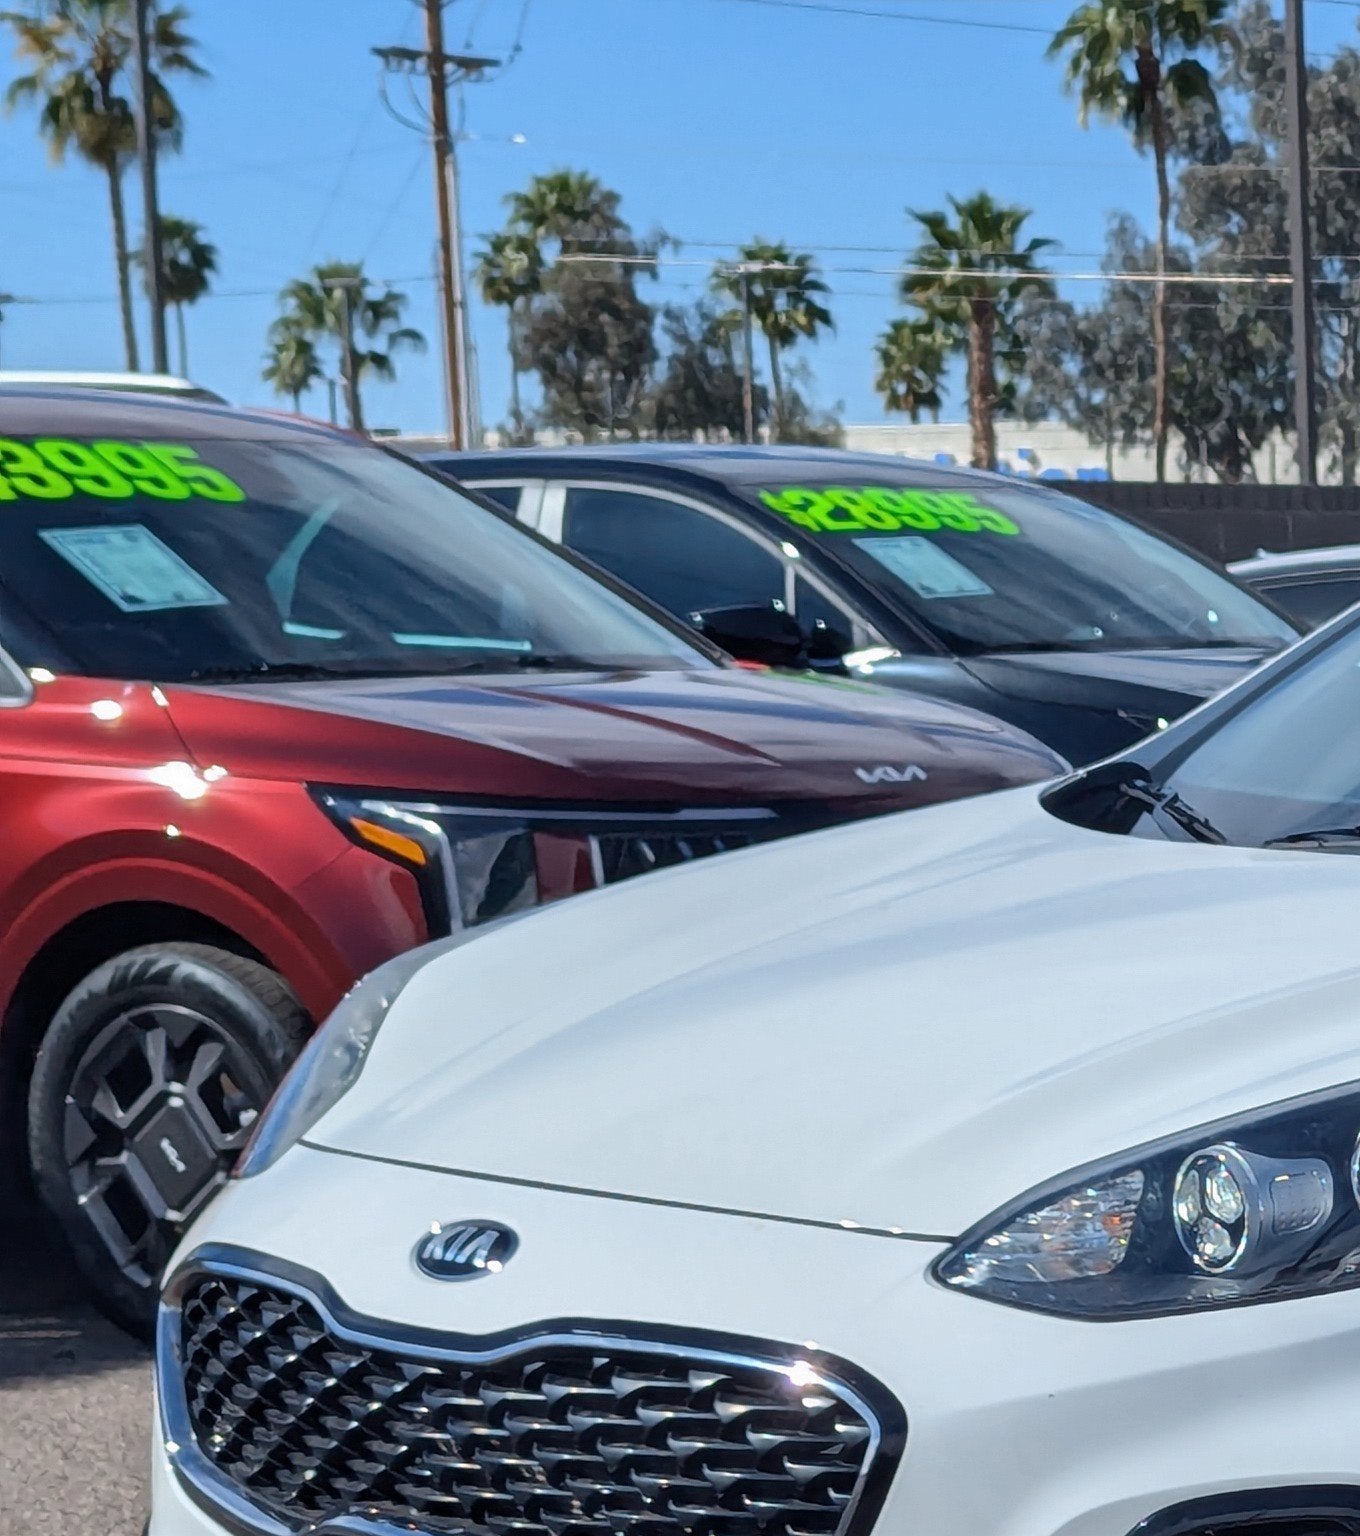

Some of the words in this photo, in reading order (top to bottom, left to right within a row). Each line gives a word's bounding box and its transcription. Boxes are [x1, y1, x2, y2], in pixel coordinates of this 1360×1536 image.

[0, 439, 246, 502] 3995
[757, 486, 1020, 535] $28995
[421, 1225, 501, 1268] KIA
